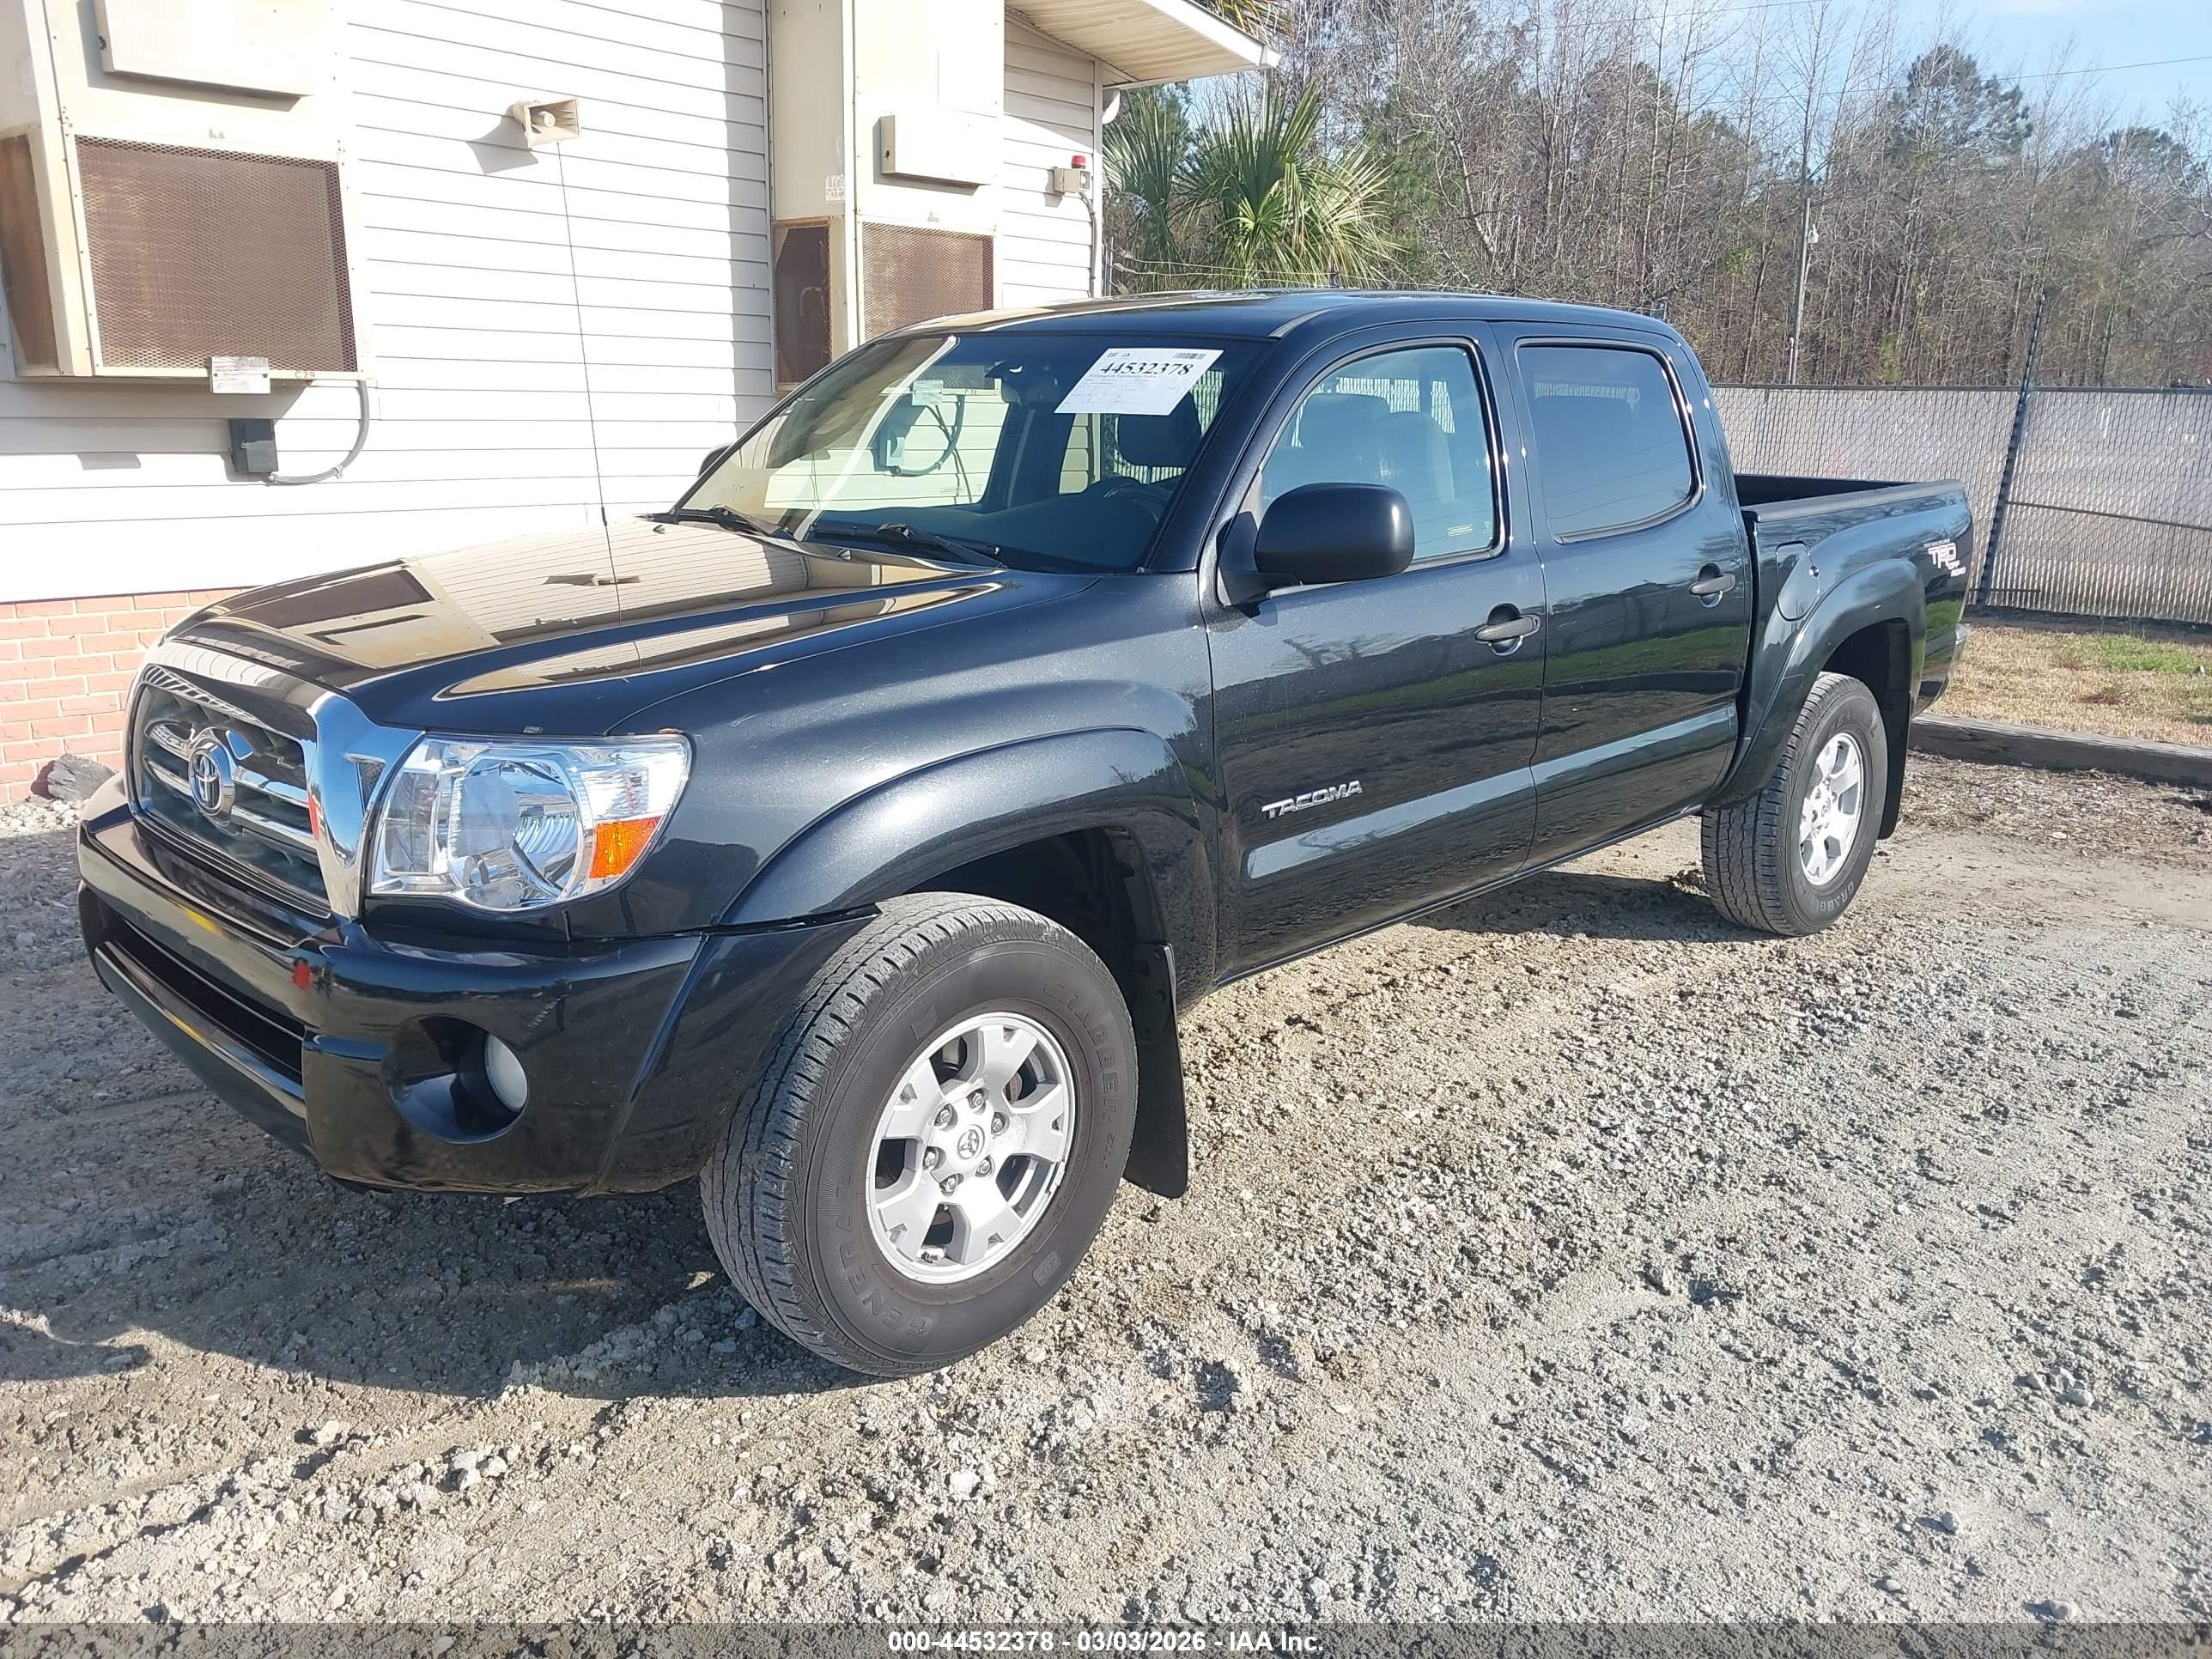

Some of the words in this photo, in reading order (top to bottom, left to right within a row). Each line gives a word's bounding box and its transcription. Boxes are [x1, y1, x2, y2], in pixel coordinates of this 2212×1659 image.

[1100, 362, 1194, 375] 44532378
[1928, 542, 1957, 569] TRD
[1261, 780, 1363, 818] TACOMA
